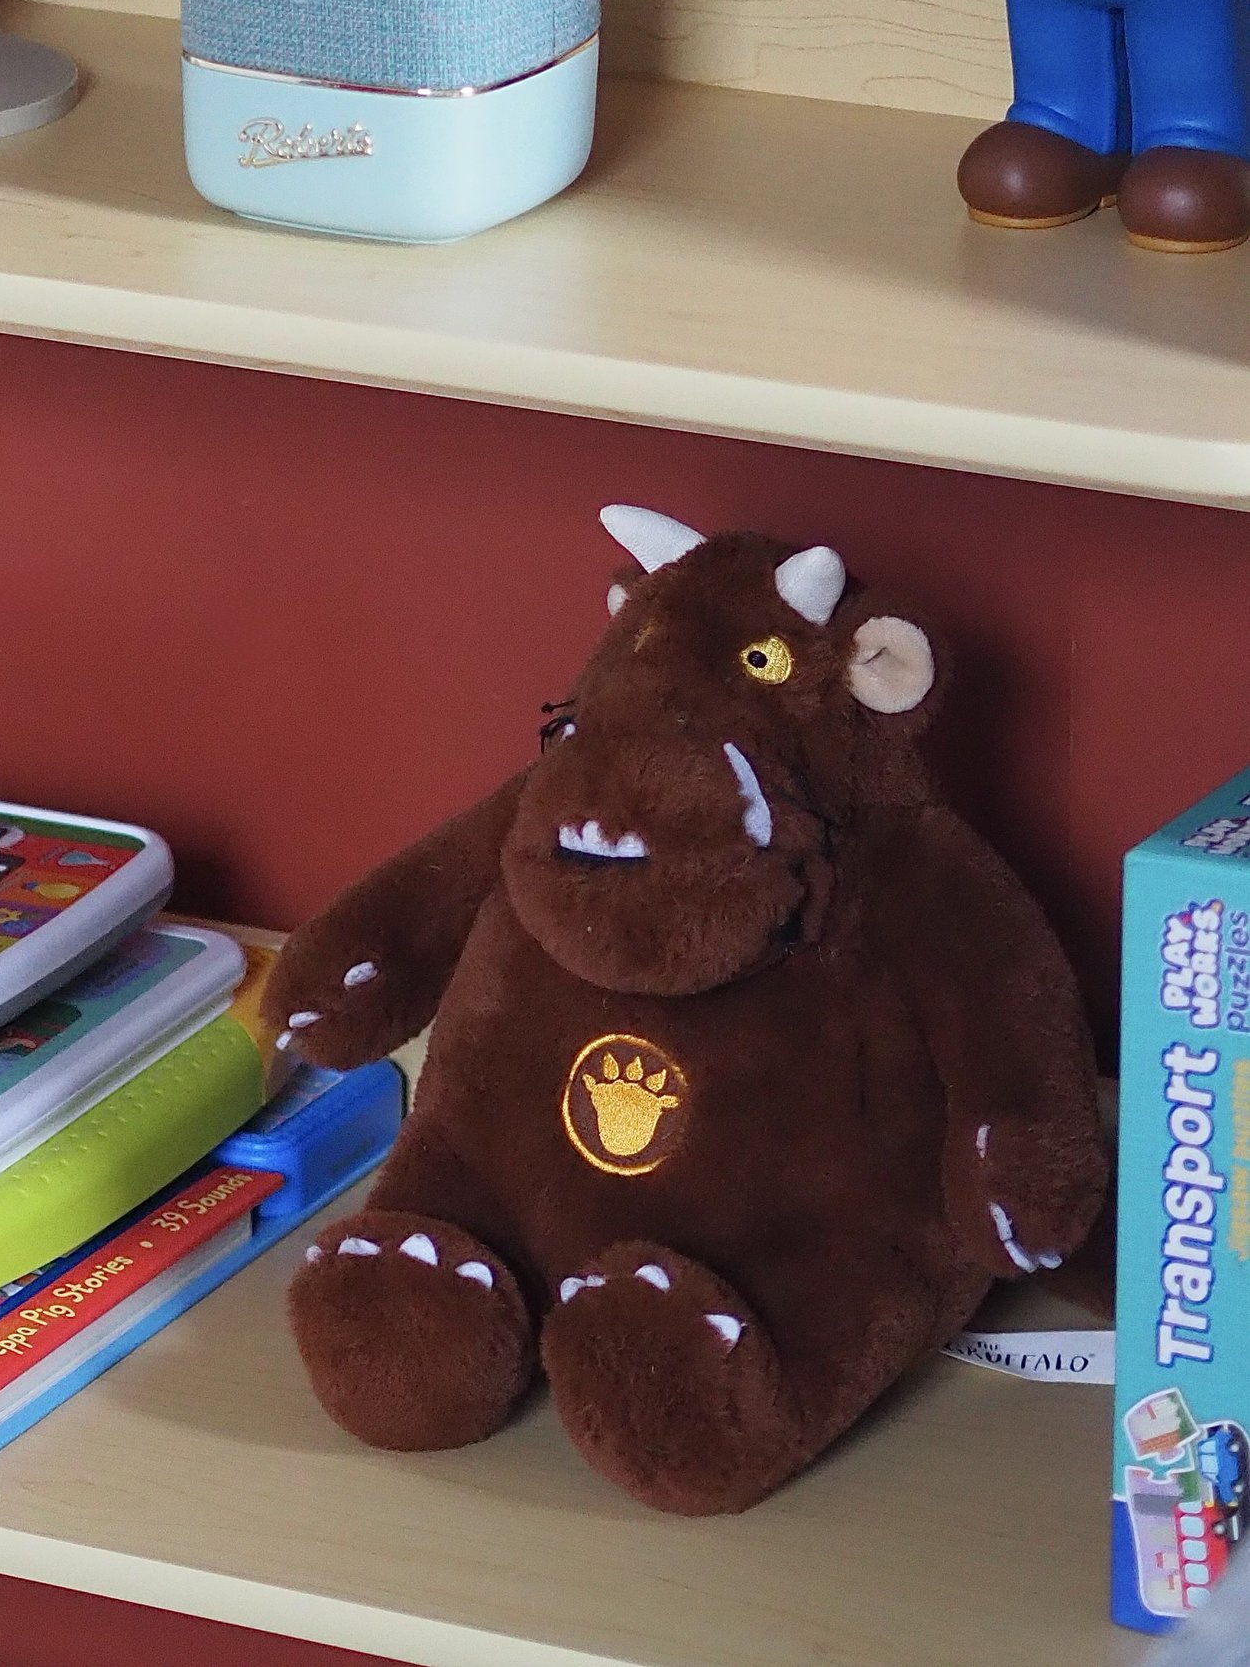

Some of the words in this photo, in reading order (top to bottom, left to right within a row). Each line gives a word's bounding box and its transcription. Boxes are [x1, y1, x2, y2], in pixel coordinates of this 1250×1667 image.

[1161, 913, 1193, 1011] PLAY
[1190, 906, 1222, 1028] WORKS
[1226, 910, 1250, 1033] puzzles
[20, 1304, 76, 1327] Pig
[53, 1254, 135, 1304] Stories
[151, 1211, 190, 1234] 39
[178, 1171, 253, 1215] Sounds
[1156, 1041, 1227, 1368] Transport
